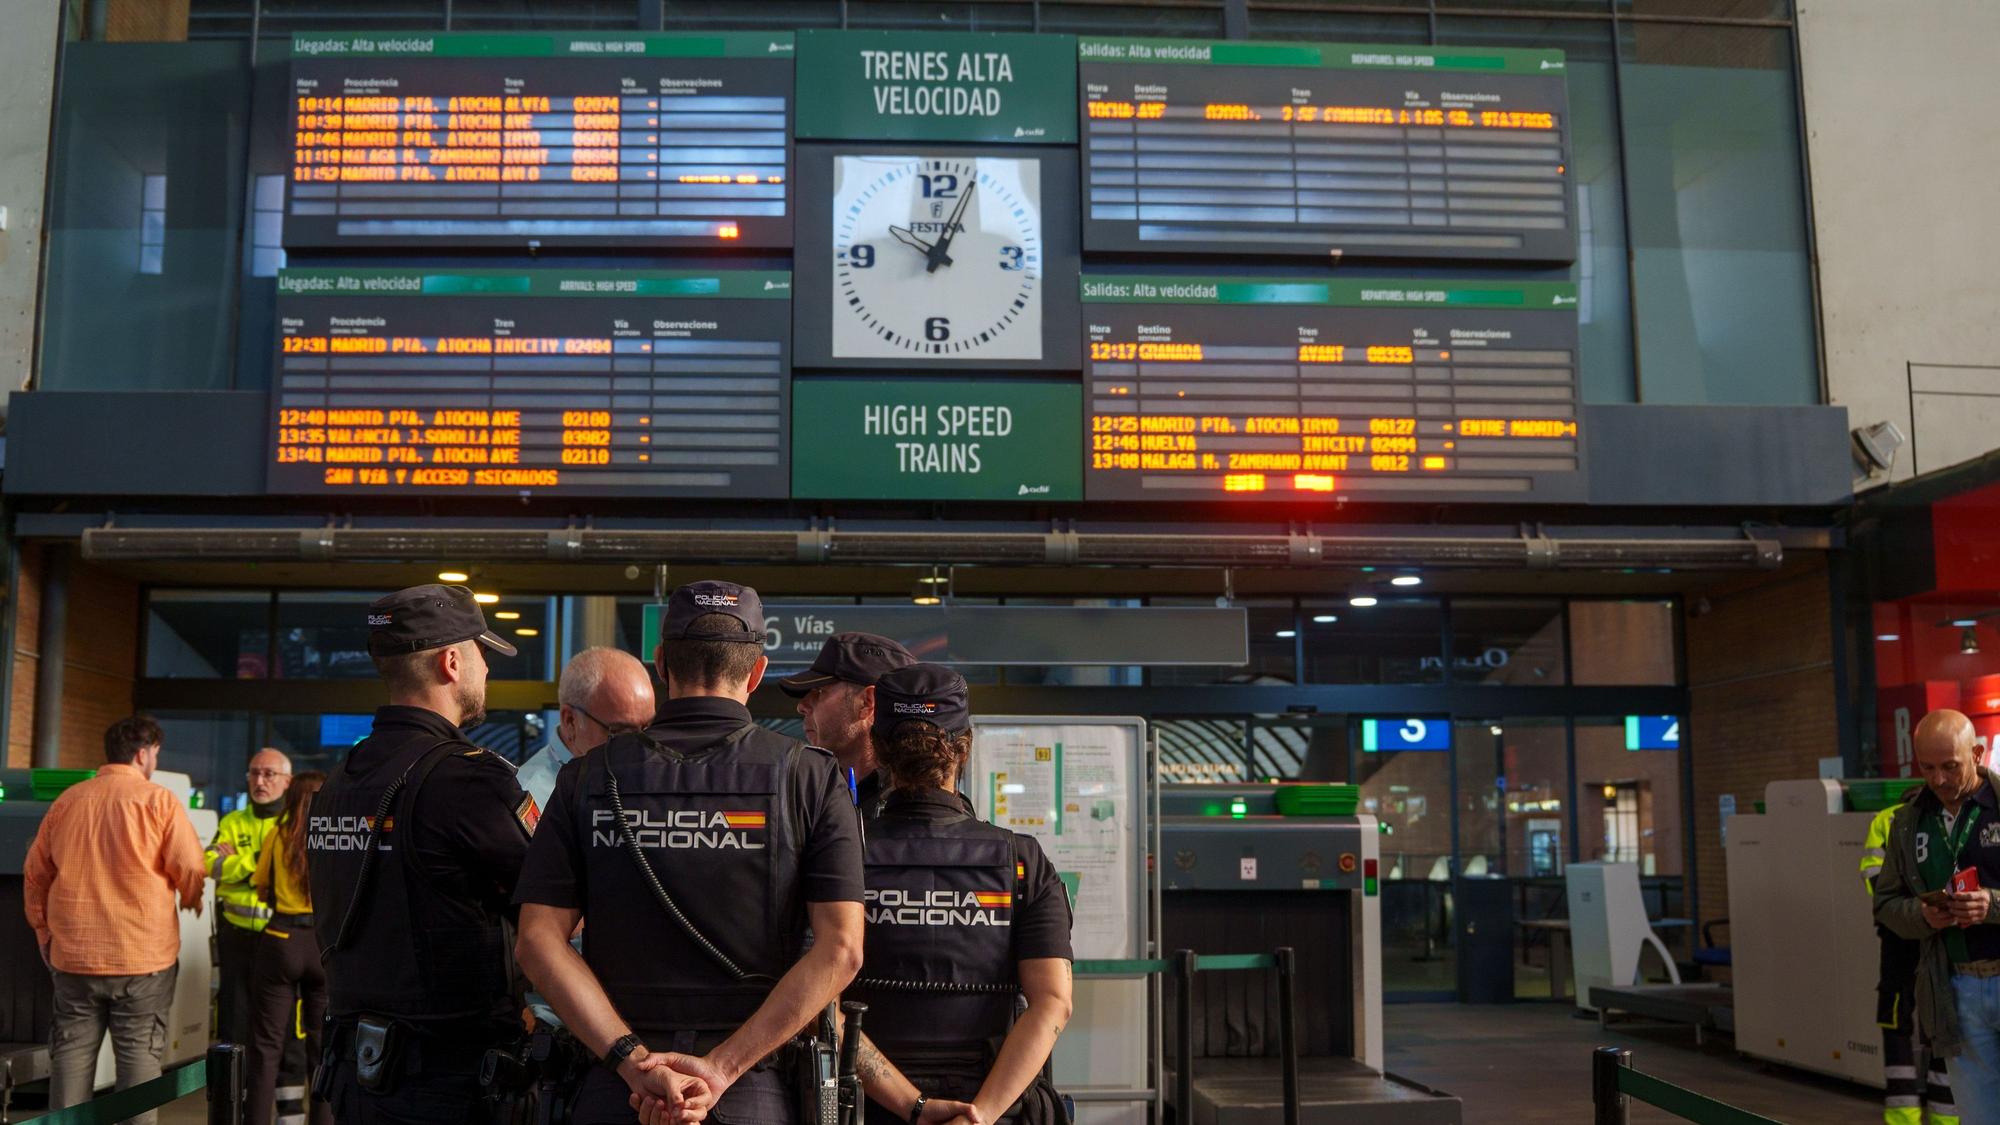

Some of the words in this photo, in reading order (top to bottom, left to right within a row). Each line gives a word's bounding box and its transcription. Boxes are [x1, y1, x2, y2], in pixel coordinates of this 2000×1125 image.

[295, 38, 349, 54] Llegadas:
[352, 38, 374, 51] Alta
[377, 38, 433, 51] velocidad
[1080, 43, 1125, 57] Salidas:
[1129, 45, 1151, 58] Alta
[1154, 45, 1211, 60] velocidad
[861, 50, 949, 81] TRENES
[957, 52, 1013, 82] ALTA
[344, 78, 398, 88] Procedencia
[505, 78, 524, 87] Tren
[660, 78, 722, 88] Observaciones
[345, 98, 399, 112] MADRID
[405, 98, 438, 111] PTA.
[449, 98, 501, 111] ATOCHA
[874, 86, 1001, 116] VELOCIDAD
[344, 115, 399, 129] MADRID
[405, 115, 437, 129] PTA.
[448, 115, 501, 129] ATOCHA
[343, 132, 397, 146] MADRID
[403, 132, 436, 146] PTA.
[447, 132, 501, 146] ATOCHA
[339, 167, 396, 180] MADRID
[401, 167, 435, 180] PTA.
[445, 167, 499, 180] ATOCHA
[917, 175, 958, 198] 12
[851, 244, 875, 268] 9
[1000, 246, 1025, 271] 3
[279, 276, 334, 292] Llegadas:
[337, 277, 360, 290] Alta
[363, 276, 420, 290] velocidad
[615, 280, 637, 292] SPEED
[1084, 283, 1129, 297] Salidas:
[1134, 284, 1156, 297] Alta
[1160, 284, 1216, 298] velocidad
[330, 317, 386, 327] Procedencia
[494, 318, 514, 328] Tren
[653, 320, 717, 330] Observaciones
[925, 317, 950, 341] 6
[1089, 324, 1111, 334] Hora
[1138, 325, 1171, 335] Destino
[1298, 327, 1318, 336] Tren
[1450, 329, 1511, 340] Observaciones
[331, 338, 387, 352] MADRID
[392, 339, 426, 352] PTA.
[437, 339, 492, 352] ATOCHA
[1092, 344, 1137, 359] 12:17
[328, 411, 384, 425] MADRID
[390, 411, 424, 425] PTA.
[434, 411, 489, 425] ATOCHA
[492, 412, 520, 426] AVE
[864, 405, 927, 435] HIGH
[937, 406, 1012, 436] SPEED
[1093, 417, 1139, 432] 12:25
[1140, 417, 1196, 432] MADRID
[1201, 417, 1236, 432] PTA.
[1245, 418, 1300, 433] ATOCHA
[328, 429, 400, 443] VALENCIA
[491, 430, 519, 444] AVE
[1141, 435, 1197, 450] HUELVA
[326, 448, 382, 462] MADRID
[388, 448, 422, 462] PTA.
[433, 448, 488, 462] ATOCHA
[491, 448, 518, 463] AVE
[896, 443, 981, 473] TRAINS
[1141, 454, 1196, 469] MALAGA
[794, 615, 834, 634] Vías
[864, 908, 1010, 926] NACIONAL
